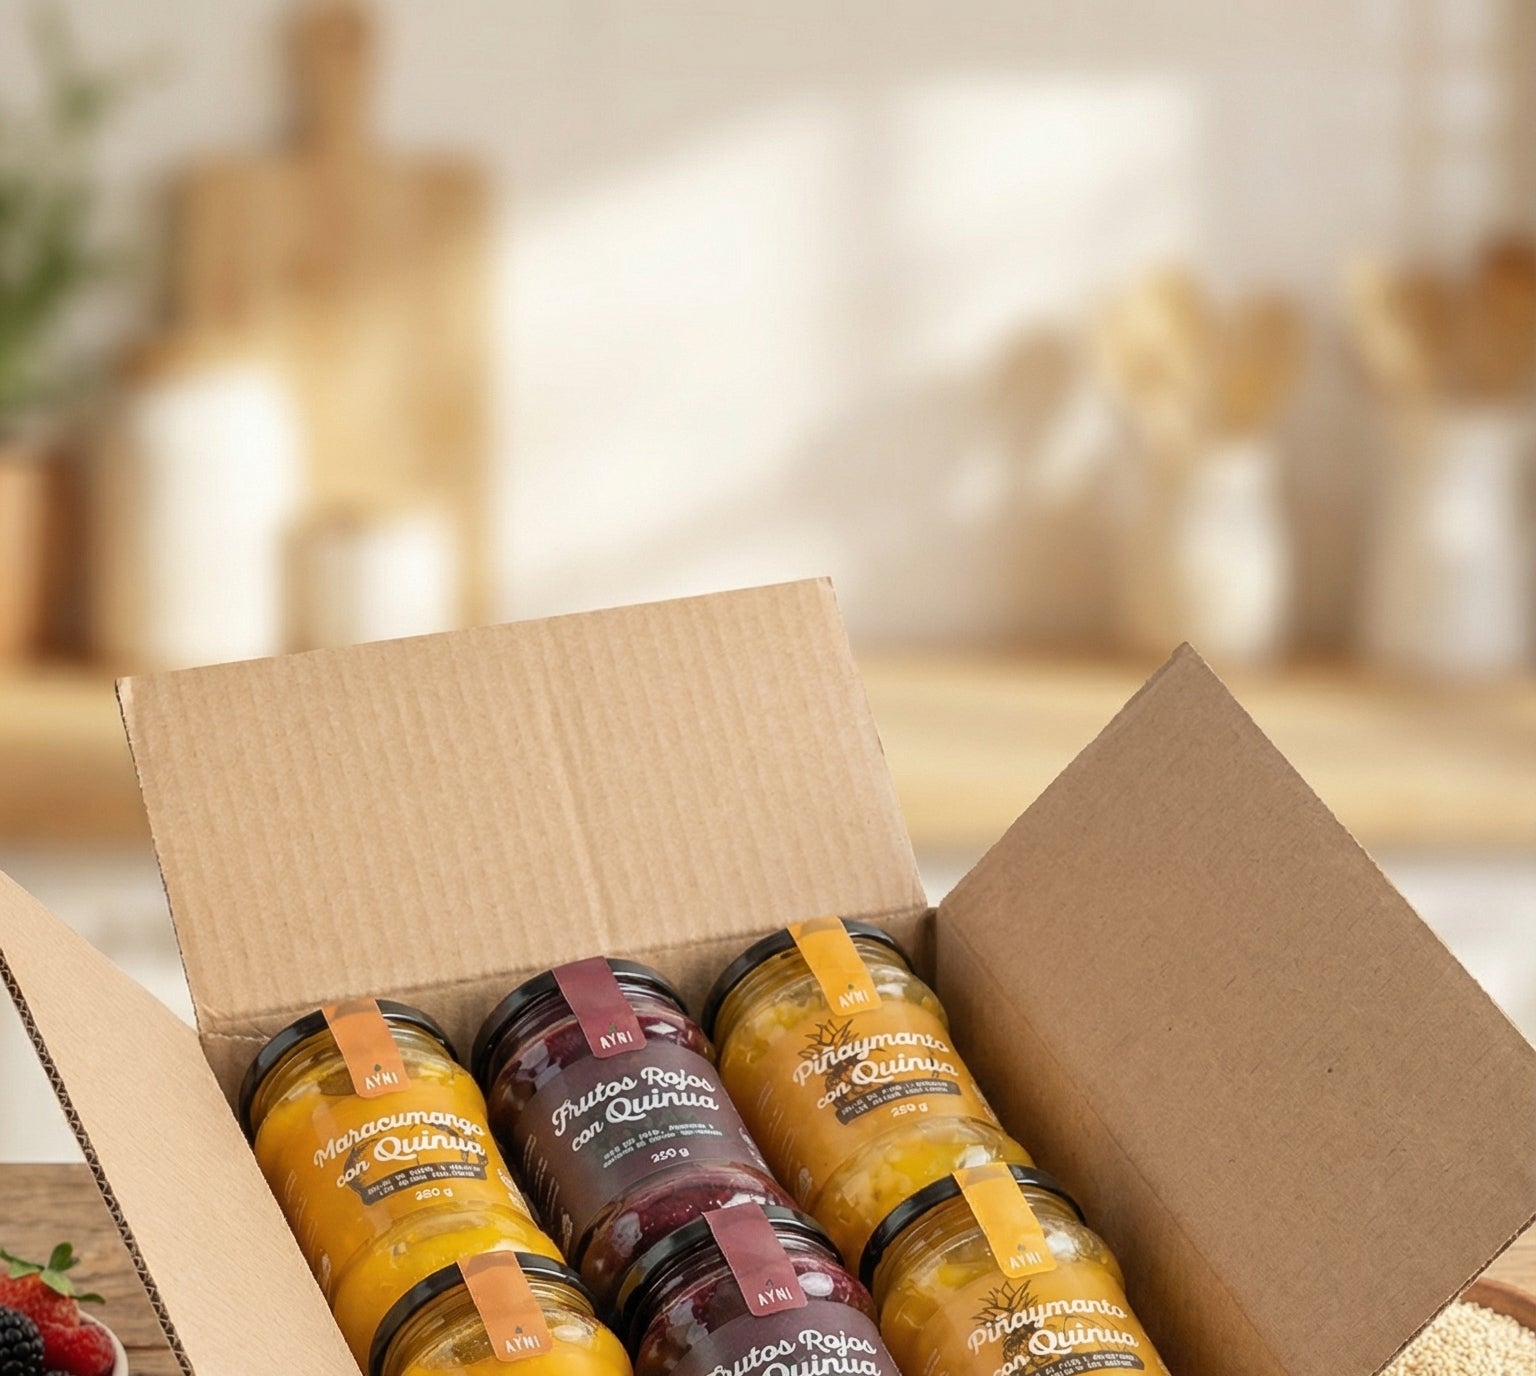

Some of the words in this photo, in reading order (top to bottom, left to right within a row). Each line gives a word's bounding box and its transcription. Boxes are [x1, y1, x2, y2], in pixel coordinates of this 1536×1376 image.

[364, 1072, 399, 1090] AYNI
[552, 1078, 637, 1137] Frutos
[641, 1066, 716, 1093] Rojos
[817, 1083, 850, 1110] con
[572, 1119, 604, 1152] con
[605, 1089, 720, 1124] Quinua
[336, 1160, 371, 1188] con
[1009, 1251, 1044, 1270] AYNI
[757, 1286, 793, 1307] AYNI
[505, 1335, 541, 1355] AYNI
[798, 1329, 878, 1357] Rojos
